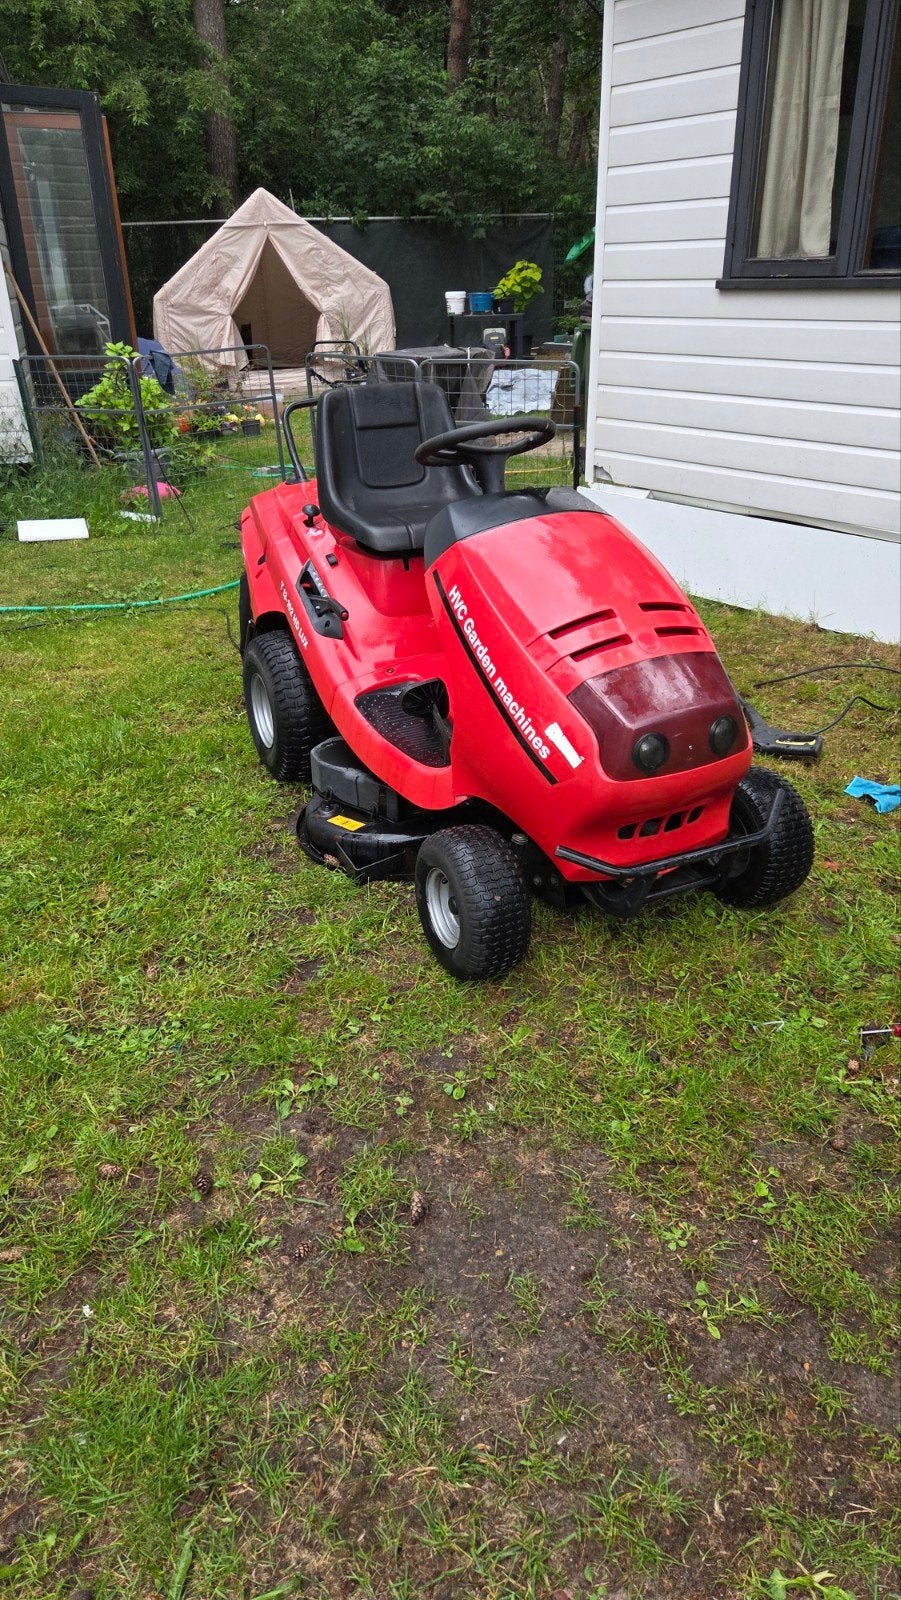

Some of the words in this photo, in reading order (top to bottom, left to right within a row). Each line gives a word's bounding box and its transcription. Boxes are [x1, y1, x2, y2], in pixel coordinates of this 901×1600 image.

[292, 613, 300, 630] HD
[298, 628, 309, 650] LUX
[448, 584, 468, 621] HVC
[463, 617, 497, 678] Garden
[493, 677, 550, 759] machines
